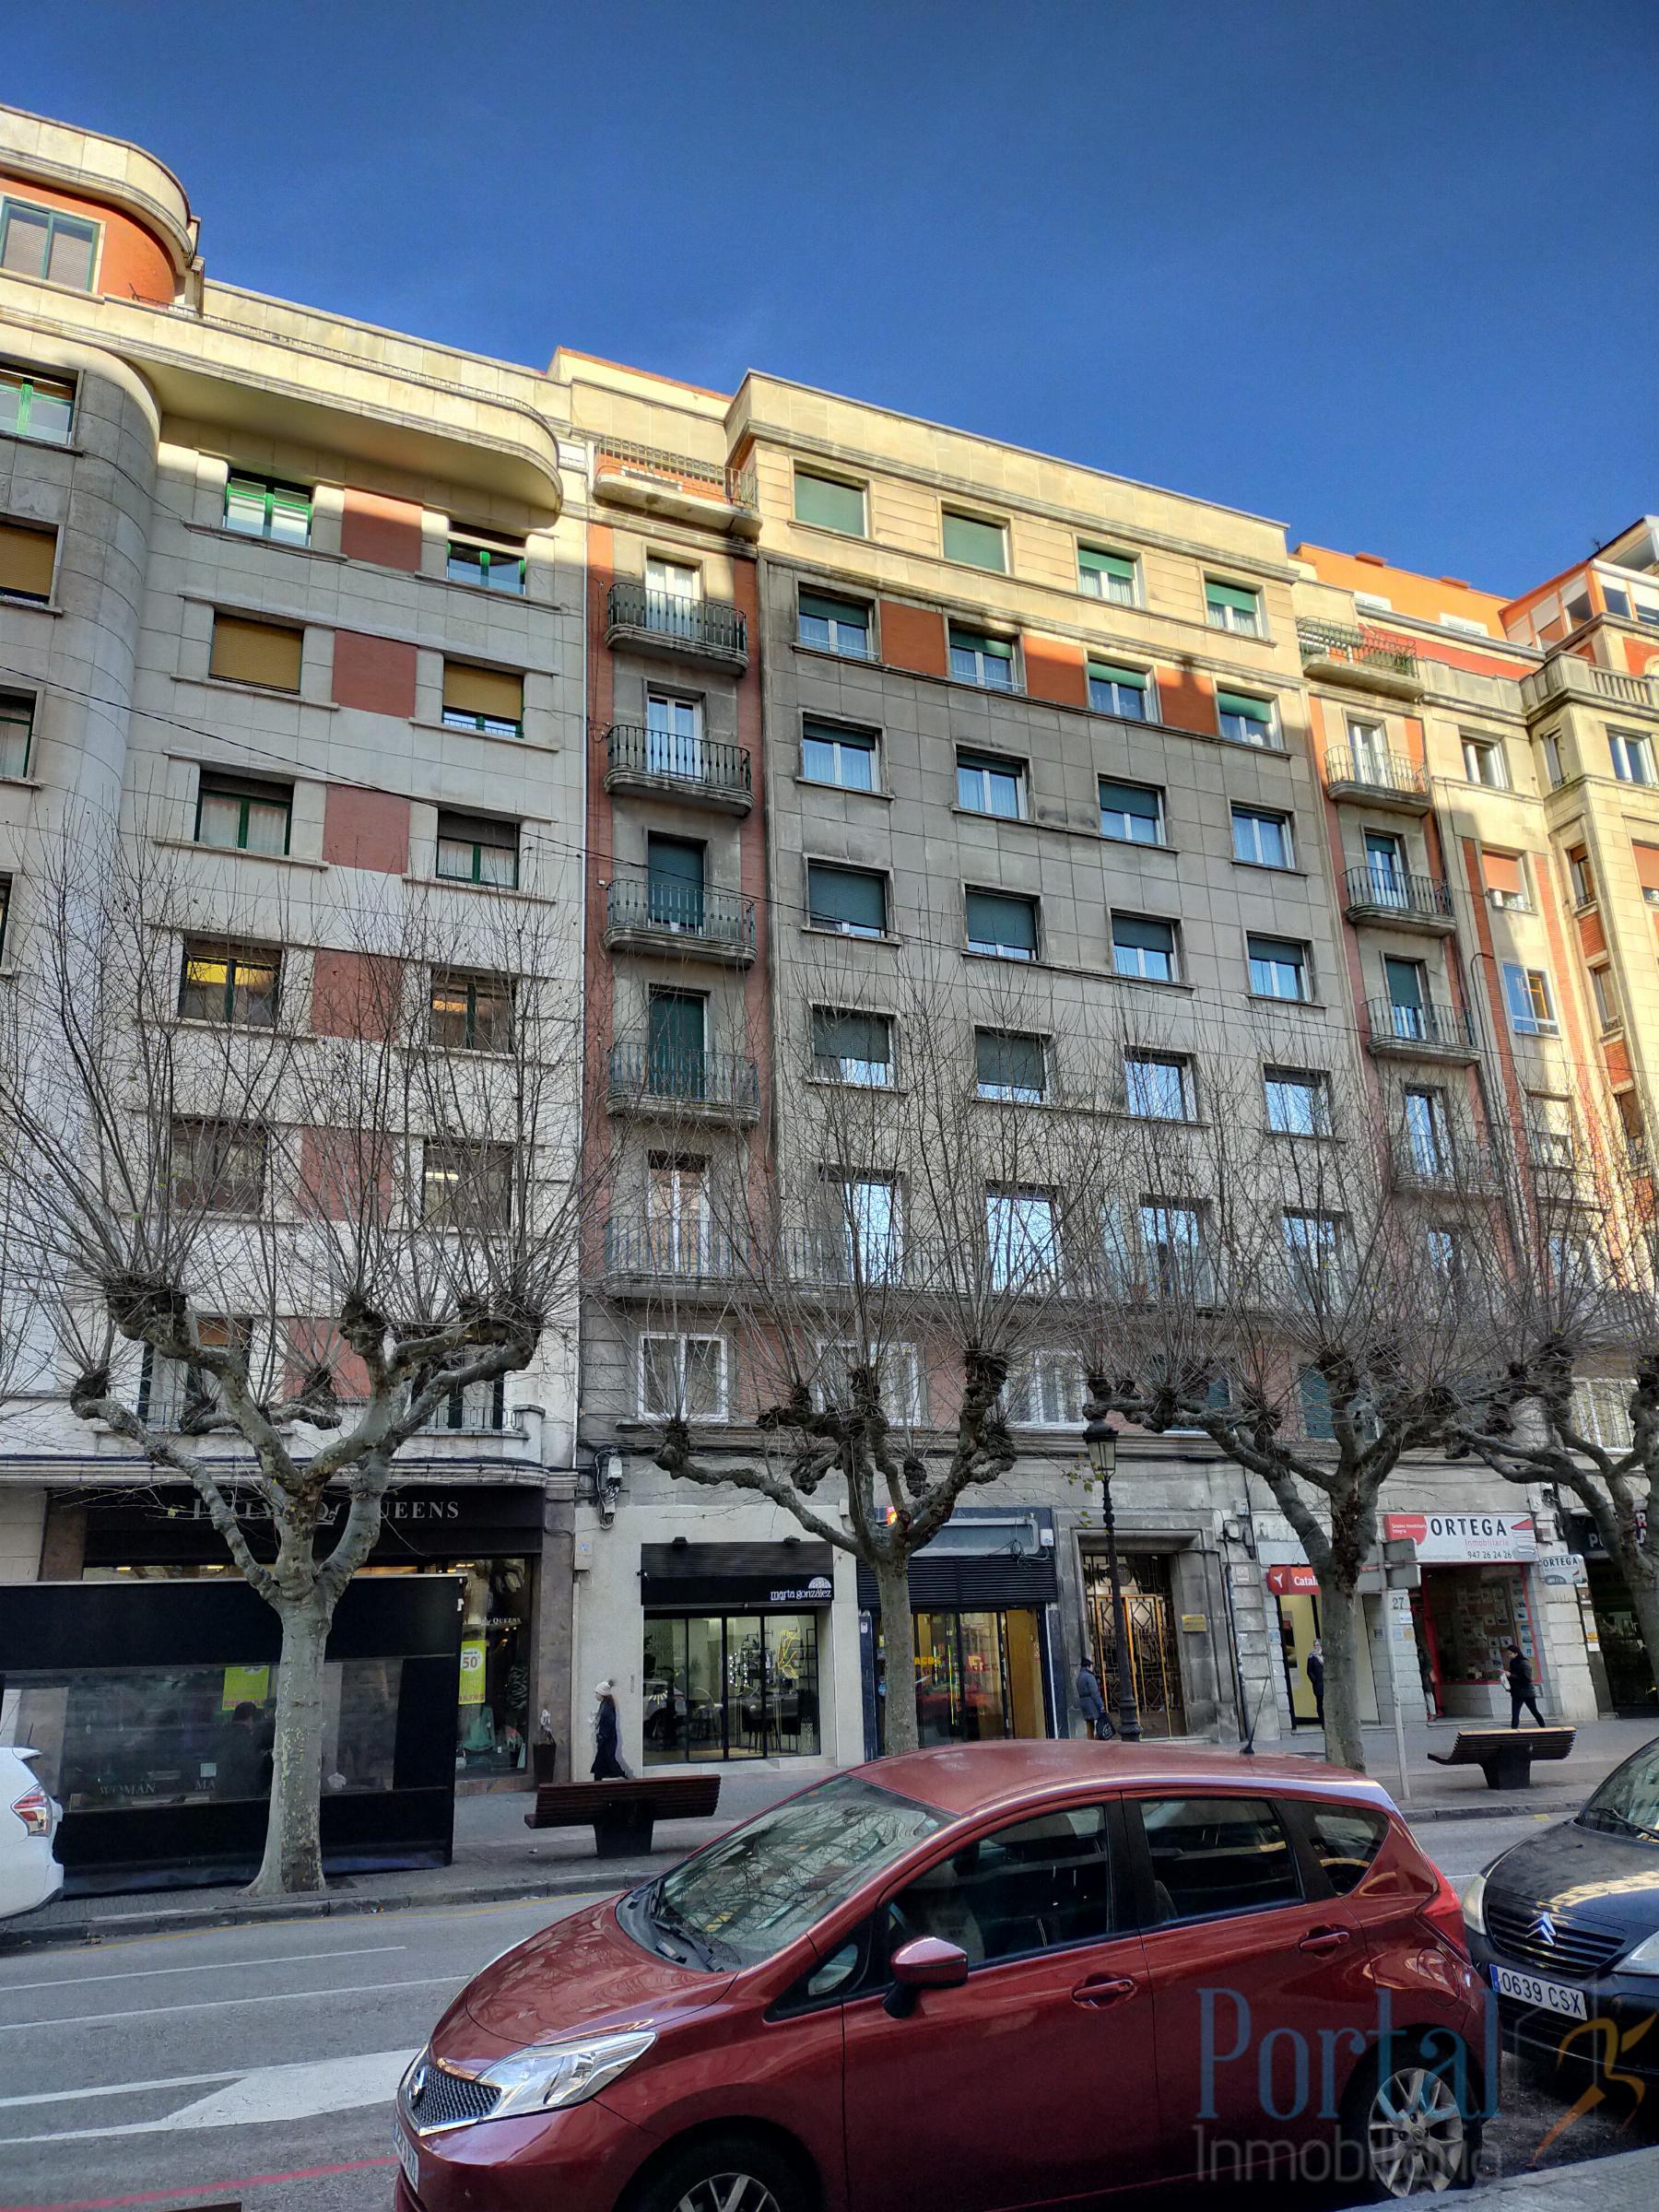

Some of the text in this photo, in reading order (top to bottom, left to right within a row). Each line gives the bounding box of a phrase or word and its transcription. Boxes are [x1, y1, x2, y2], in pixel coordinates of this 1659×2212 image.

[379, 1500, 459, 1520] UEENS
[1430, 1518, 1508, 1536] ORTEGA
[1465, 1538, 1510, 1547] Inmobiliaria
[1467, 1551, 1480, 1559] 947
[1483, 1551, 1491, 1559] 26
[1493, 1550, 1501, 1559] 24
[1504, 1550, 1512, 1559] 26
[1543, 1557, 1578, 1568] ORTEGA
[1294, 1576, 1319, 1586] Catal
[770, 1590, 795, 1601] marta
[1392, 1597, 1405, 1610] 27
[99, 1782, 157, 1795] WOMAN
[1501, 1972, 1582, 2015] 0639 CSX
